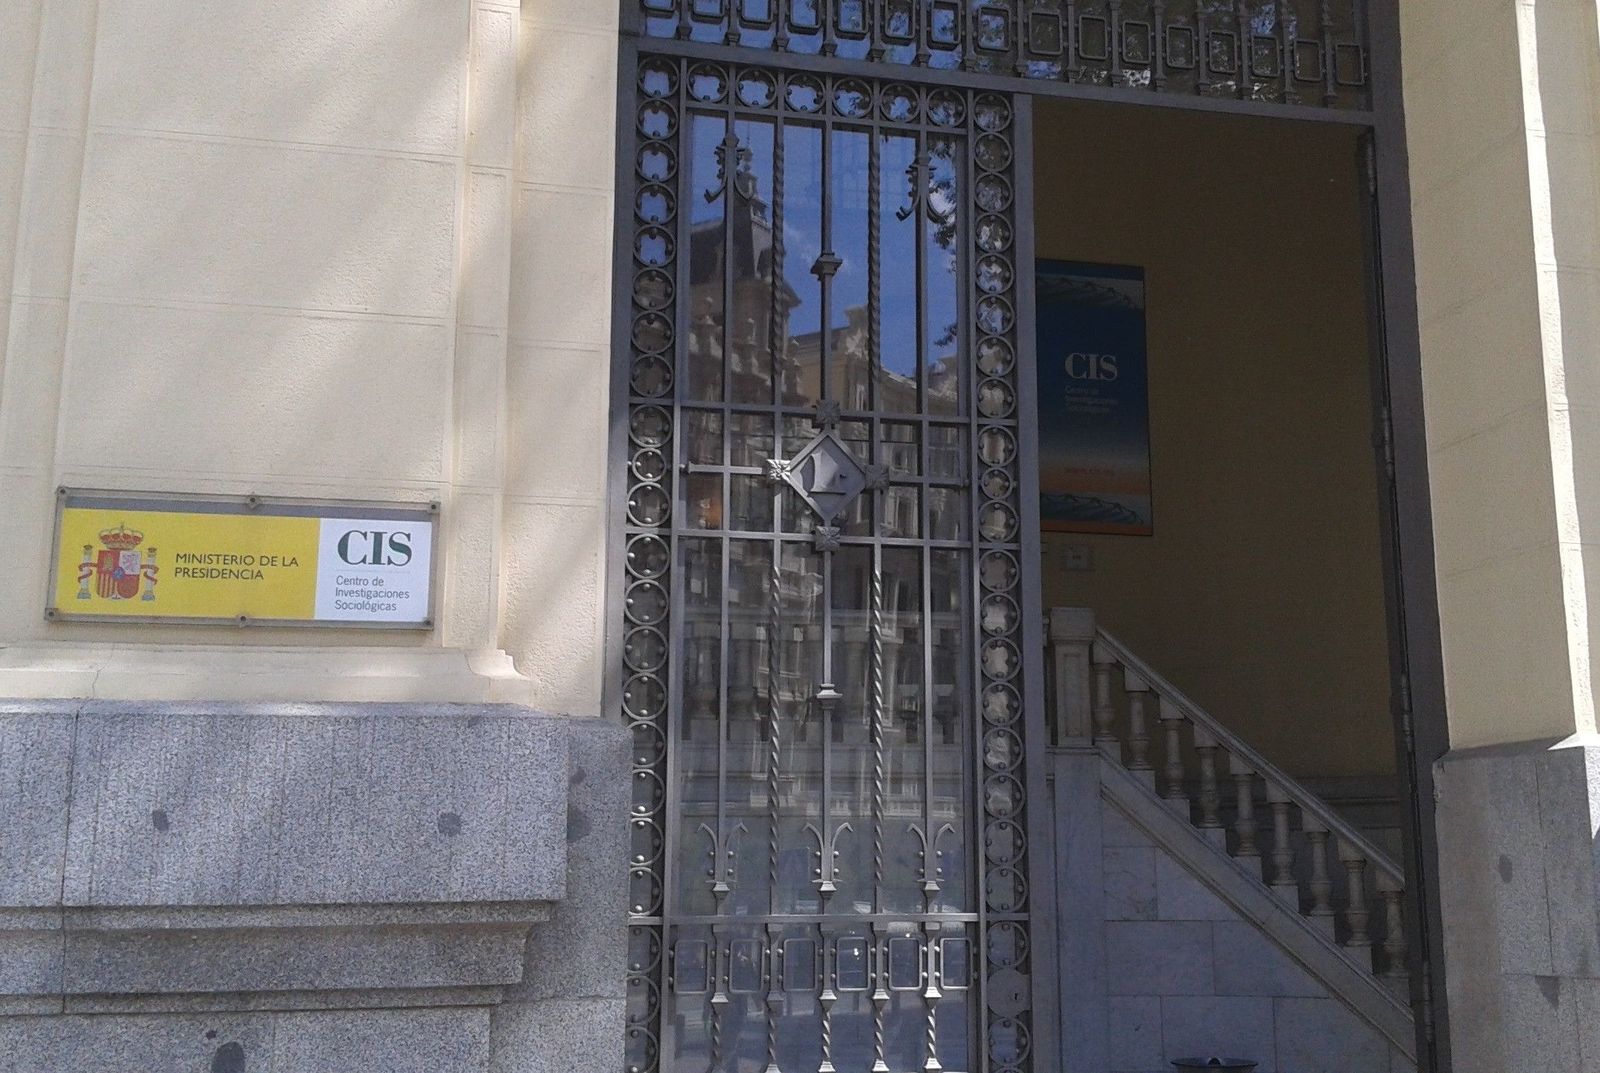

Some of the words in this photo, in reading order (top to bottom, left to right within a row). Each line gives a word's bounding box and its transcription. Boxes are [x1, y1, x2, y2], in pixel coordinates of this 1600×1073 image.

[1064, 352, 1118, 381] CIS
[337, 530, 412, 567] CIS
[175, 553, 255, 566] MINISTERIO
[259, 555, 278, 566] DE
[282, 556, 299, 567] LA
[174, 567, 264, 580] PRESIDENCIA
[336, 575, 369, 586] Centro
[372, 576, 384, 587] de
[335, 587, 410, 600] Investigaciones
[334, 599, 397, 613] Sociológicas
